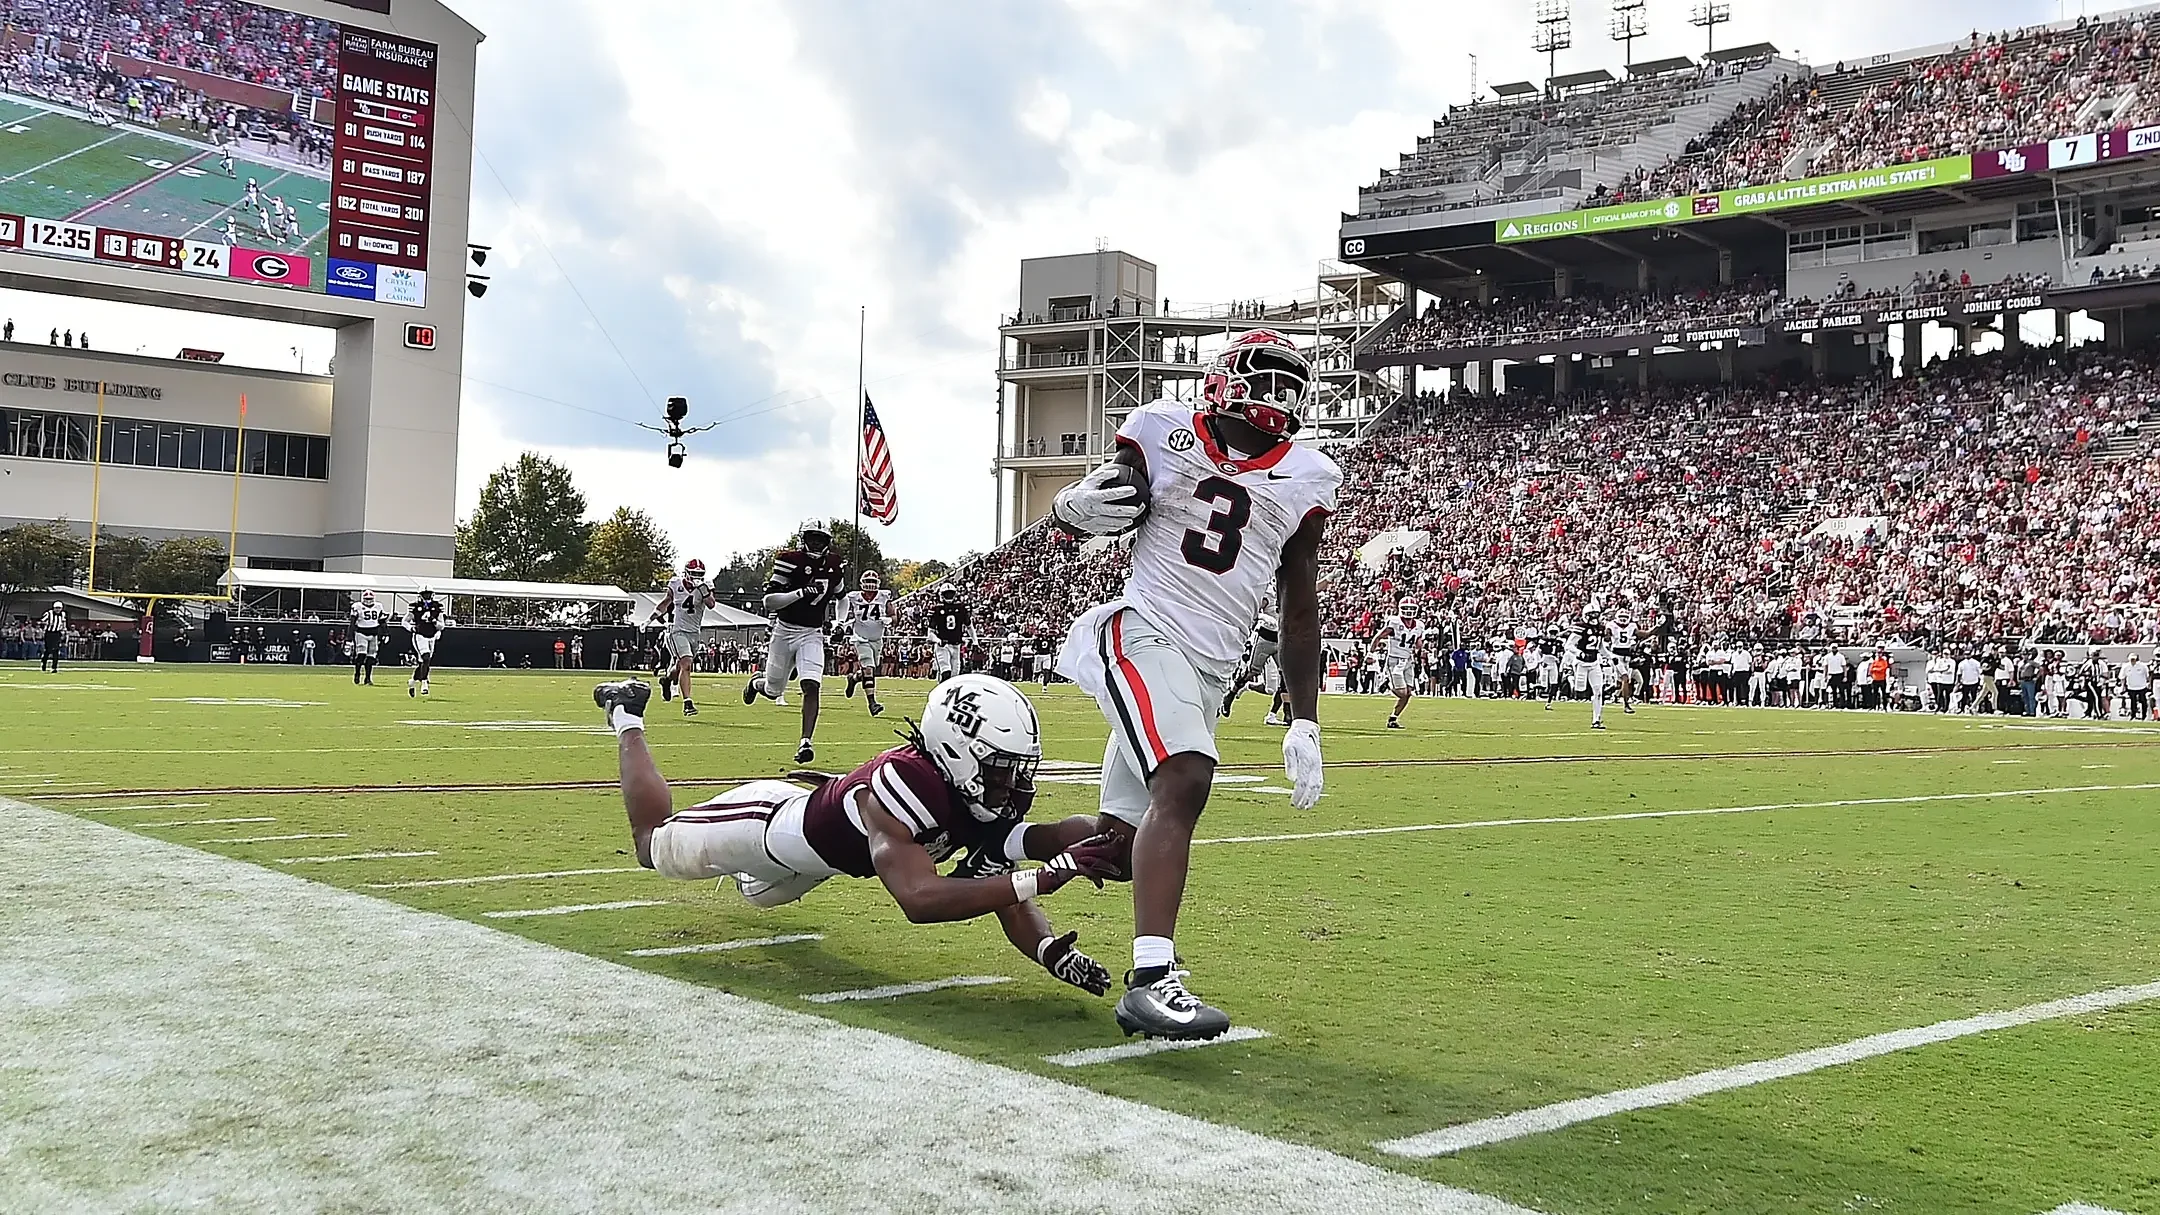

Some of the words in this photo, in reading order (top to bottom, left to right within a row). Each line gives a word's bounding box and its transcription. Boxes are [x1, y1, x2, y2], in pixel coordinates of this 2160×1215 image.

[371, 39, 396, 51] FARM
[398, 45, 434, 59] BUREAU
[376, 49, 428, 68] INSURANCE
[342, 74, 383, 96] GAME
[386, 83, 429, 105] STATS
[344, 122, 357, 137] 81
[409, 135, 425, 150] 114
[2135, 131, 2160, 146] 2ND
[2066, 141, 2078, 161] 7
[343, 159, 355, 173] 81
[364, 166, 380, 176] PASS
[381, 169, 400, 179] YARDS
[407, 171, 425, 185] 187
[1734, 192, 1766, 207] GRAB
[1767, 192, 1777, 202] A
[1777, 185, 1817, 201] LITTLE
[1819, 180, 1857, 196] EXTRA
[1859, 174, 1887, 189] HAIL
[362, 202, 379, 211] TOTAL
[381, 205, 399, 214] YARDS
[404, 207, 423, 221] 301
[1592, 214, 1620, 224] OFFICIAL
[1621, 211, 1639, 220] BANK
[1639, 209, 1648, 218] OF
[1648, 208, 1662, 217] THE
[1, 222, 10, 236] 7
[31, 223, 91, 251] 12:35
[339, 233, 352, 247] 10
[114, 240, 121, 252] 3
[143, 243, 156, 257] 41
[407, 244, 418, 257] 19
[1347, 242, 1363, 253] CC
[193, 247, 220, 269] 24
[385, 278, 416, 288] CRYSTAL
[394, 286, 407, 294] SKY
[386, 293, 415, 303] CASINO
[1962, 299, 2002, 313] JOHNIE
[2006, 296, 2041, 309] COOKS
[1877, 310, 1903, 323] JACK
[1905, 306, 1947, 320] CRISTIL
[1784, 318, 1818, 331] JACKIE
[1822, 315, 1862, 328] PARKER
[416, 329, 431, 344] 10
[1662, 333, 1679, 344] JOE
[1686, 328, 1740, 342] FORTUNATO
[2, 372, 56, 390] CLUB
[63, 377, 162, 400] BUILDING
[1169, 430, 1194, 450] SEC
[1180, 475, 1252, 575] 3
[810, 579, 829, 605] 7
[681, 595, 696, 614] 4
[858, 604, 880, 620] 74
[1399, 633, 1416, 648] 14
[1619, 631, 1628, 643] 5
